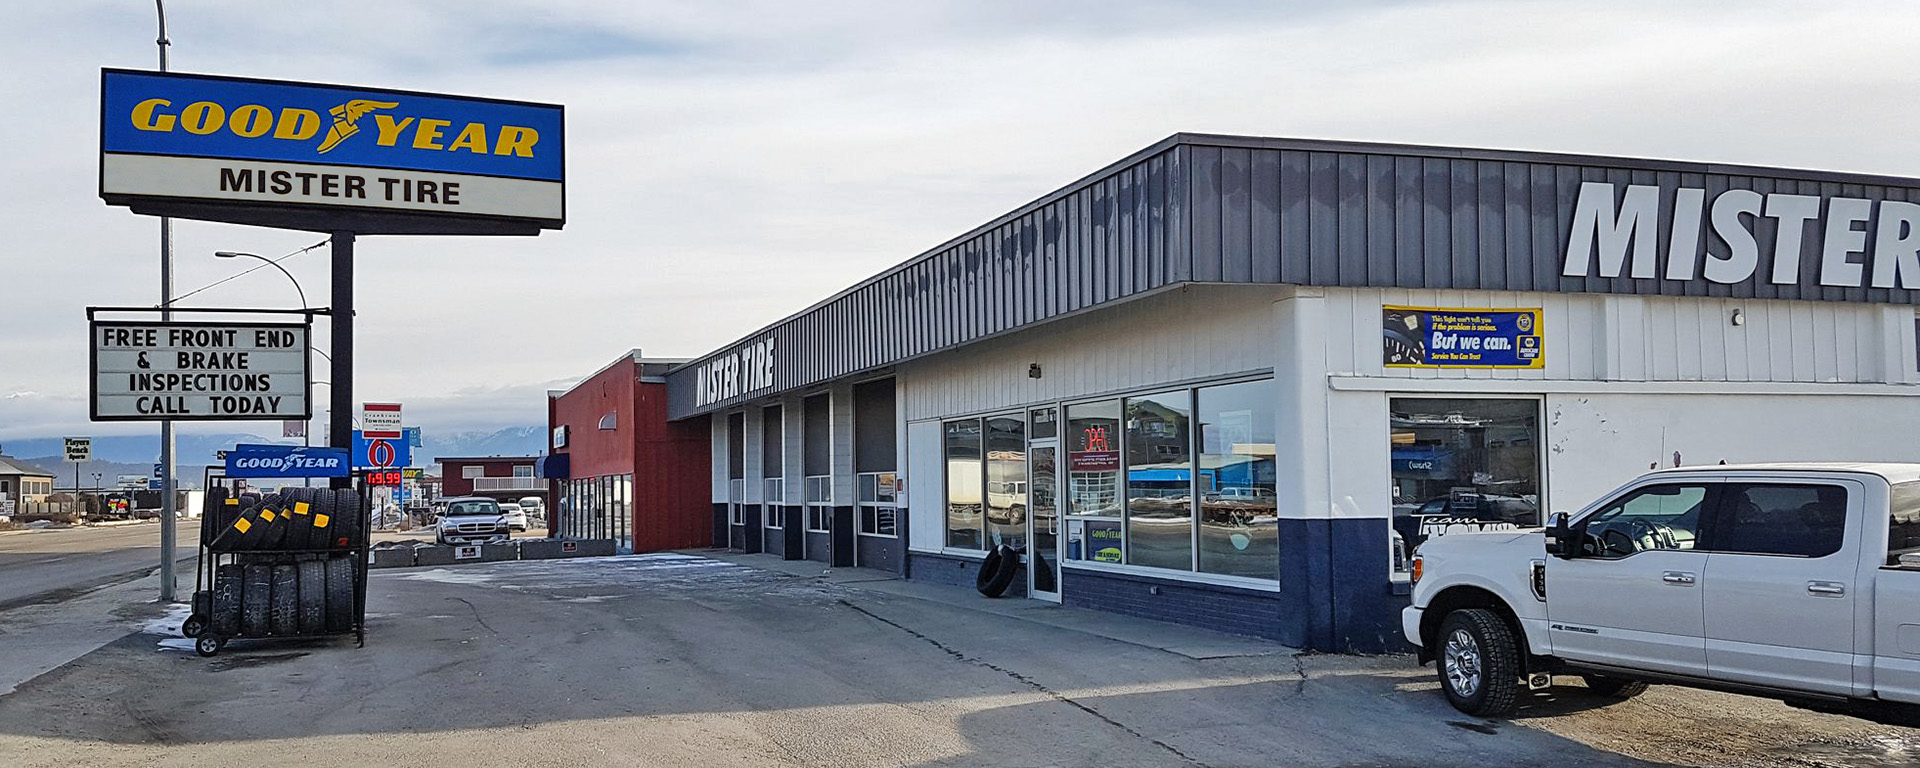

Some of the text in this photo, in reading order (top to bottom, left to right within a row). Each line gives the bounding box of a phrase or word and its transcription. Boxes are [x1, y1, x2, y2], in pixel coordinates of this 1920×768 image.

[220, 168, 460, 205] MISTER TIRE
[1563, 181, 1920, 289] MISTER
[1448, 323, 1470, 331] problem
[103, 329, 295, 348] FREE FRONT END
[1432, 331, 1458, 350] But
[1460, 337, 1480, 350] we
[1484, 337, 1511, 350] can.
[137, 351, 248, 369] & BRAKE
[696, 337, 774, 407] MISTER TIRE
[129, 373, 270, 391] INSPECTIONS
[136, 396, 281, 414] CALL TODAY
[65, 438, 89, 447] Players
[1411, 514, 1479, 535] Team
